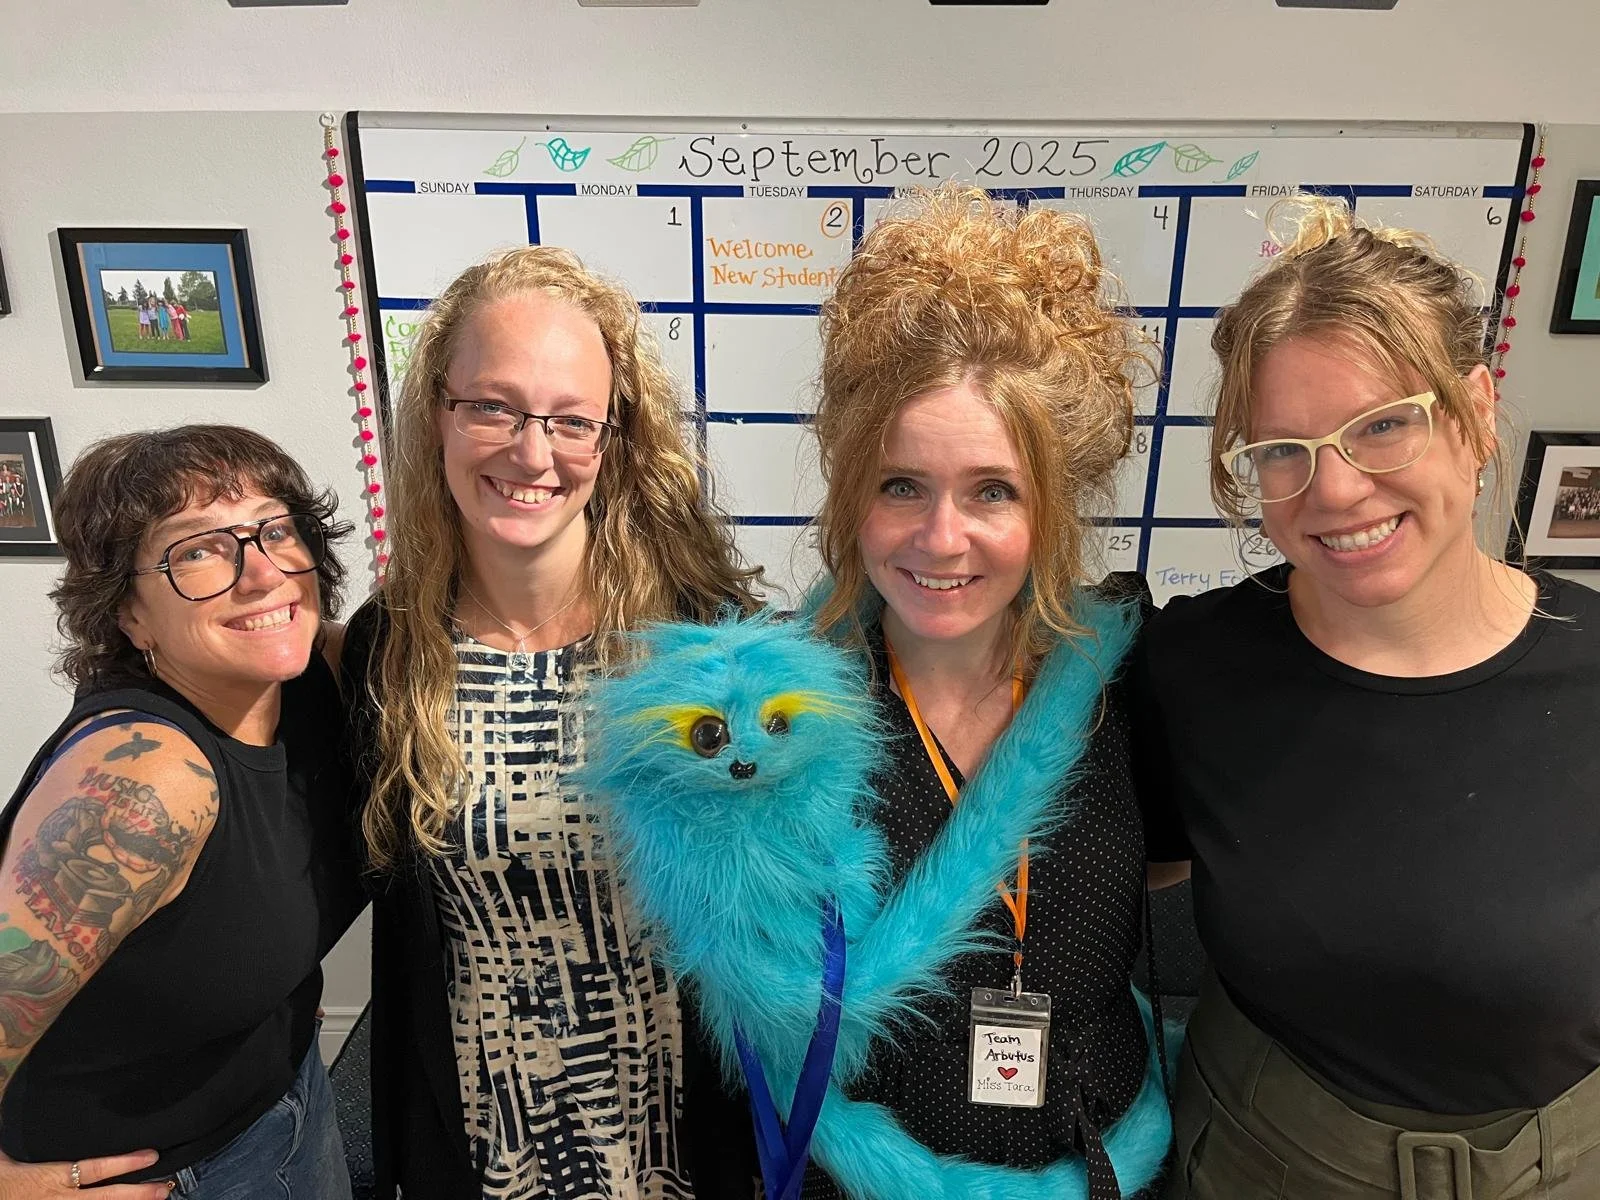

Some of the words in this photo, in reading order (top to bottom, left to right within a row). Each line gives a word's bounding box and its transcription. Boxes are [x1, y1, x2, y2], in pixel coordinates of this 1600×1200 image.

[678, 136, 951, 184] September
[975, 137, 1110, 177] 2025
[420, 182, 471, 194] SUNDAY
[581, 184, 633, 196] MONDAY
[749, 186, 804, 198] TUESDAY
[1069, 186, 1135, 198] THURSDAY
[1251, 185, 1296, 196] FRIDAY
[1414, 186, 1479, 197] SATURDAY
[667, 206, 682, 226] 1
[826, 206, 843, 227] 2
[1152, 207, 1169, 230] 4
[1486, 206, 1502, 225] 6
[706, 237, 814, 259] Welcome
[710, 263, 758, 285] New
[668, 317, 682, 341] 8
[1107, 533, 1136, 551] 25
[1248, 537, 1277, 556] 26
[1155, 567, 1210, 590] Terry
[1220, 569, 1247, 586] Fo
[982, 1032, 1022, 1046] Team
[984, 1048, 1035, 1063] Arbutus
[977, 1076, 1002, 1091] Miss
